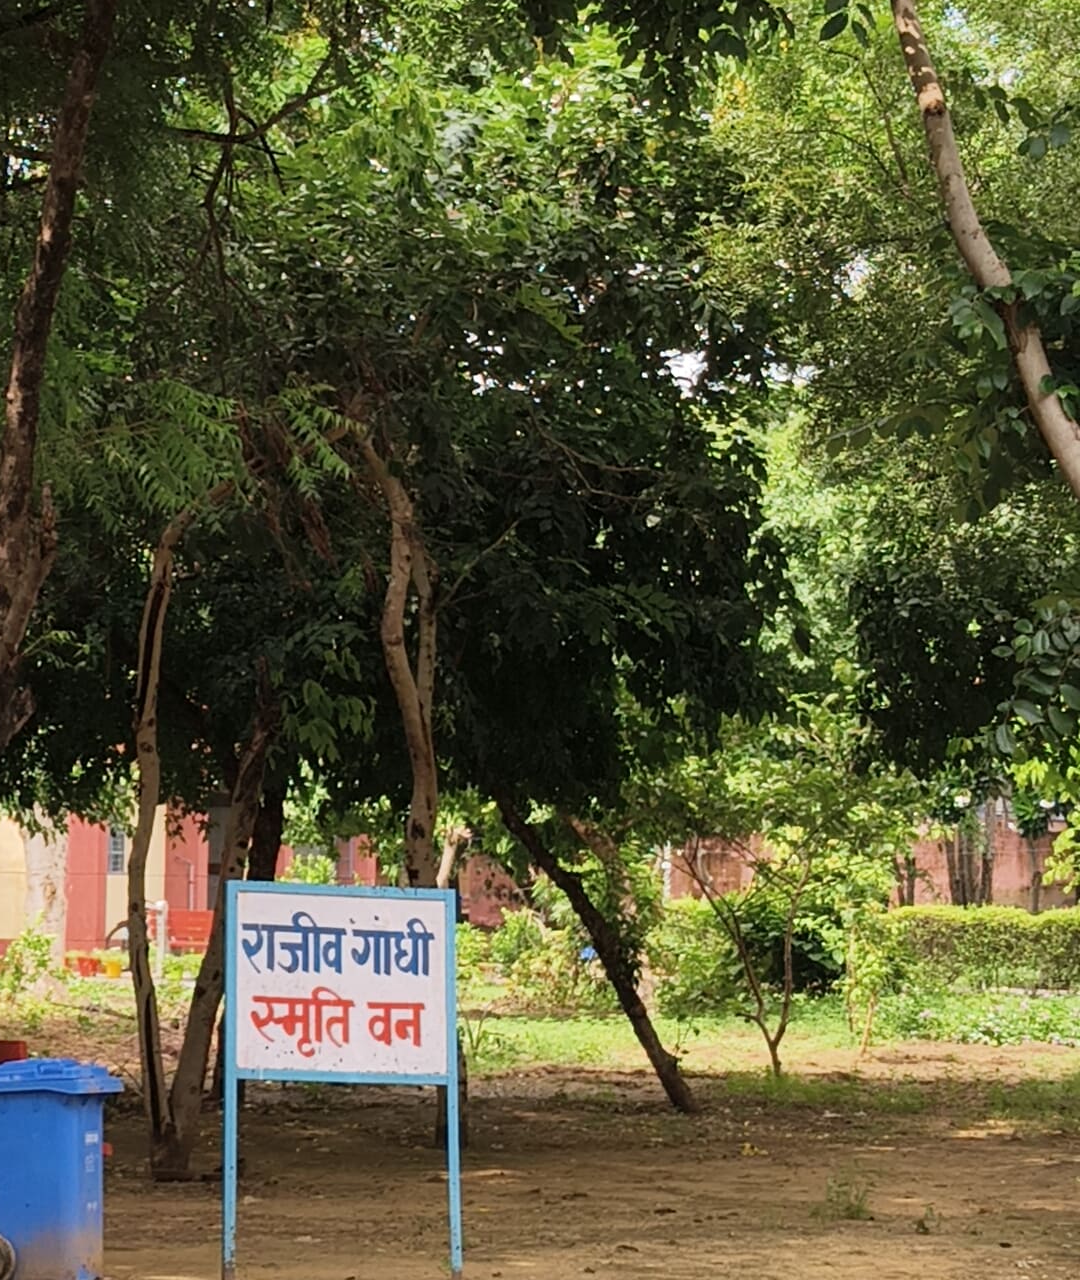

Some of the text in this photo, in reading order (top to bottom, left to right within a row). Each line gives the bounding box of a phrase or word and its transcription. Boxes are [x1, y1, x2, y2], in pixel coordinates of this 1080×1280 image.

[241, 911, 347, 974] राजीव
[250, 986, 425, 1058] स्मृति वन
